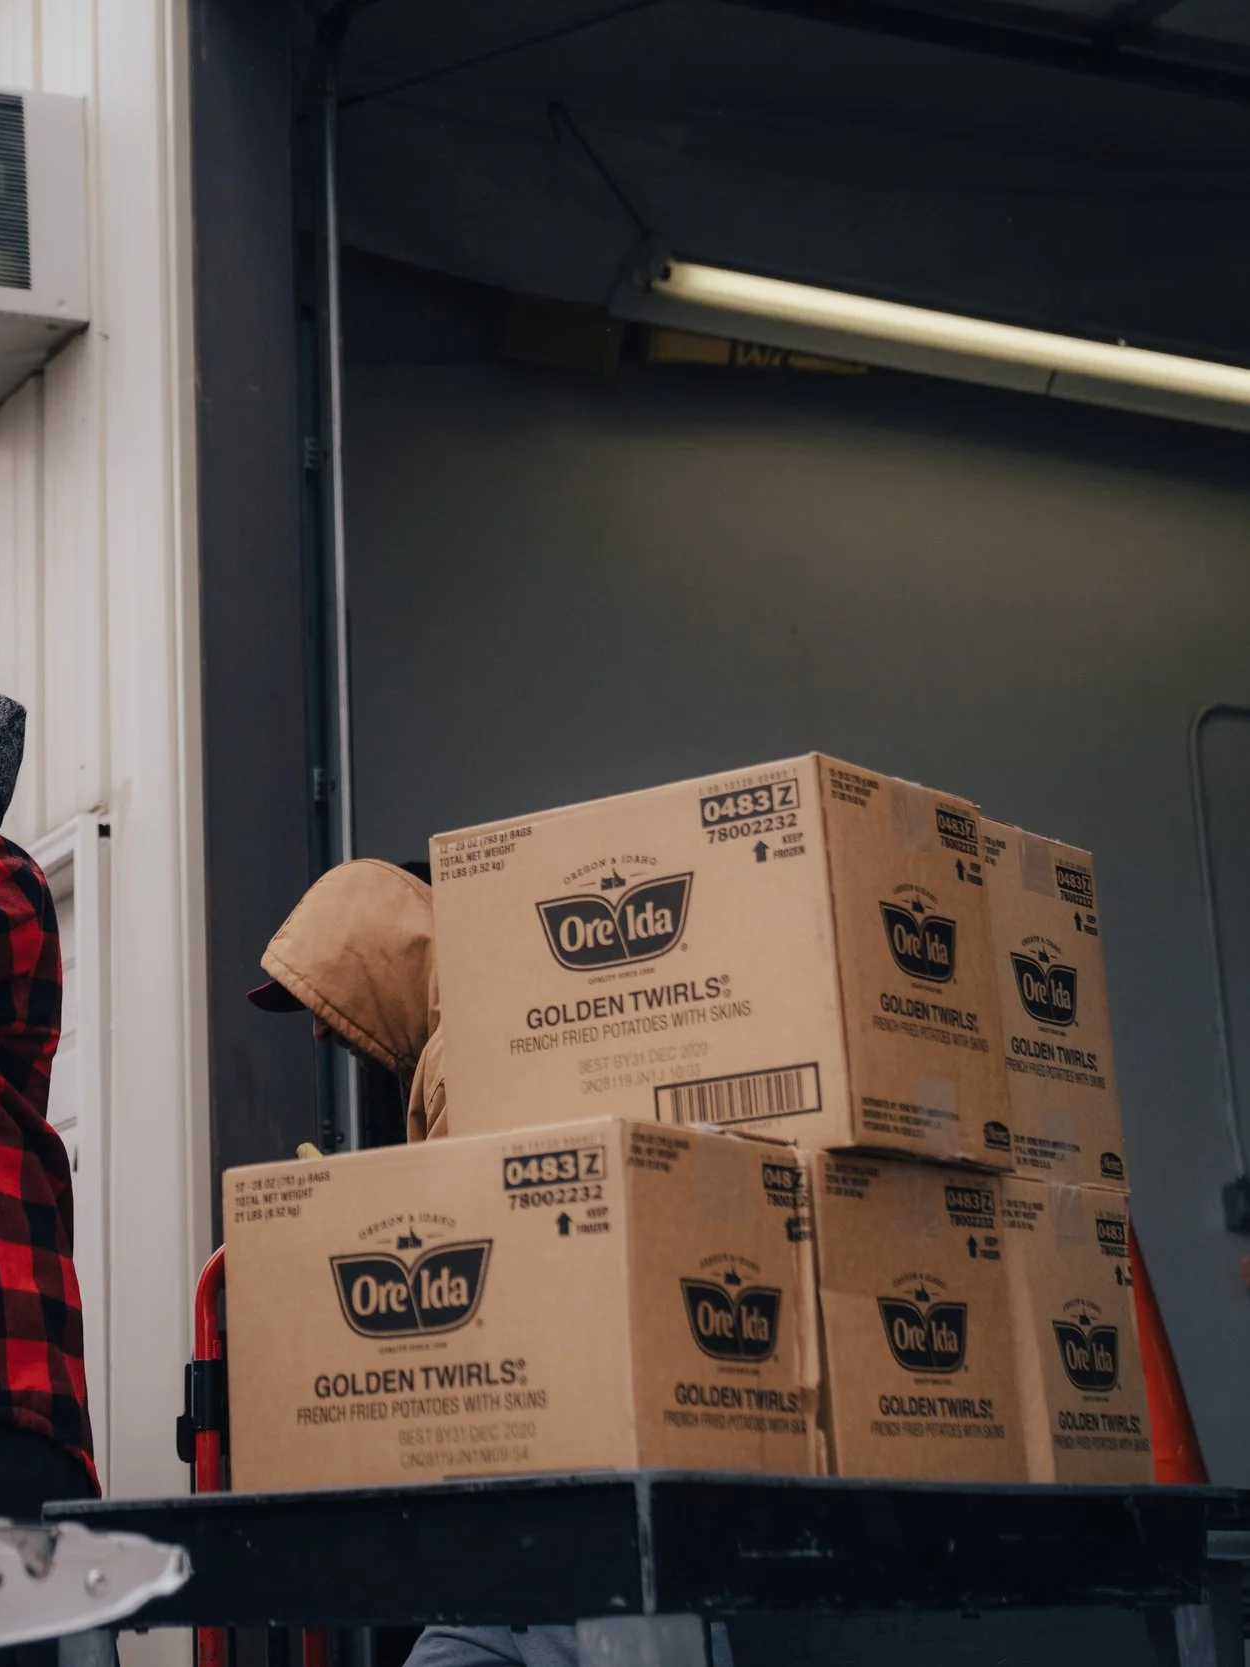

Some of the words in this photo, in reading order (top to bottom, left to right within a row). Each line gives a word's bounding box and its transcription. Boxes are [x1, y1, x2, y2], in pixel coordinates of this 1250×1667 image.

[509, 827, 532, 839] BAGS
[706, 812, 797, 845] 78002232
[782, 832, 804, 845] KEEP
[439, 855, 464, 868] TOTAL
[466, 850, 481, 861] NET
[484, 843, 516, 858] WEIGHT
[773, 845, 805, 860] FROZEN
[440, 871, 449, 881] 21
[451, 867, 467, 879] LBS
[469, 863, 490, 877] (9.52
[492, 860, 504, 871] kg)
[563, 859, 606, 886] OREGON
[621, 855, 658, 866] IDAHO
[559, 915, 614, 953] Ore
[625, 901, 674, 941] Ida
[893, 923, 922, 959] Ore
[925, 932, 950, 965] Ida
[880, 992, 930, 1021] GOLDEN
[1022, 972, 1047, 1004] Ore
[1050, 979, 1071, 1010] Ida
[510, 1034, 559, 1056] FRENCH
[562, 1026, 599, 1047] FRIED
[602, 1014, 668, 1040] POTATOES
[671, 1007, 707, 1027] WITH
[710, 999, 752, 1022] SKINS
[526, 994, 624, 1030] GOLDEN
[579, 1056, 609, 1075] BEST
[651, 1046, 677, 1064] DEC
[1011, 1036, 1055, 1062] GOLDEN
[508, 1184, 603, 1210] 78002232
[352, 1274, 408, 1316] Ore
[420, 1267, 469, 1310] Ida
[696, 1300, 734, 1339] Ore
[740, 1305, 769, 1341] Ida
[893, 1317, 927, 1353] Ore
[931, 1320, 960, 1353] Ida
[1065, 1339, 1090, 1371] Ore
[1092, 1342, 1114, 1372] Ida
[314, 1369, 415, 1400] GOLDEN
[675, 1382, 742, 1408] GOLDEN
[297, 1404, 346, 1426] FRENCH
[350, 1401, 388, 1422] FRIED
[391, 1397, 460, 1419] POTATOES
[462, 1393, 500, 1414] WITH
[503, 1389, 548, 1411] SKINS
[878, 1394, 937, 1417] GOLDEN
[1058, 1410, 1100, 1432] GOLDEN
